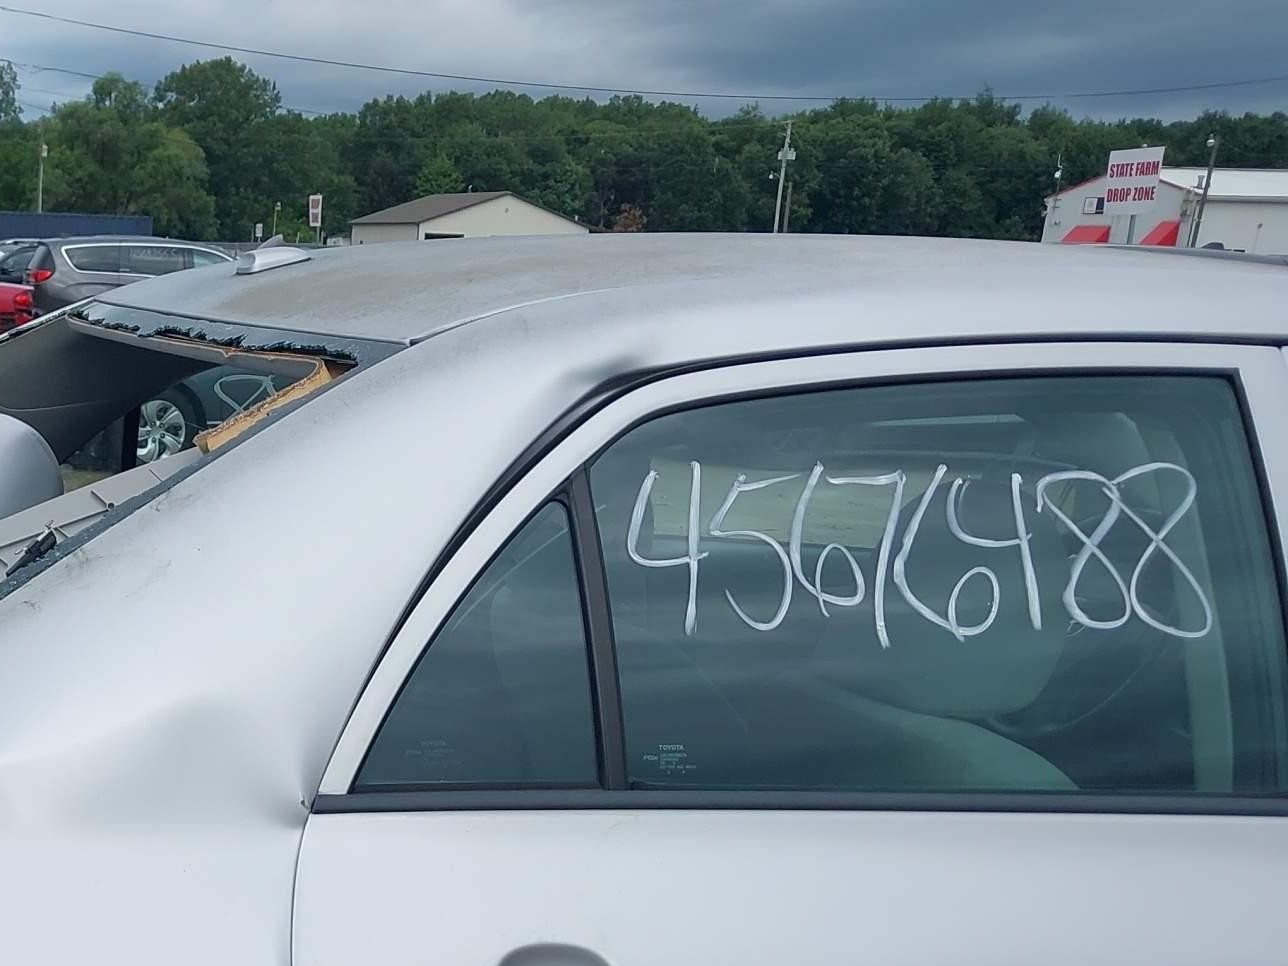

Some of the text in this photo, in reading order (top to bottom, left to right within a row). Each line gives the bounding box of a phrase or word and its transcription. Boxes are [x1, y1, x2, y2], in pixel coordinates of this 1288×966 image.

[1109, 161, 1160, 178] STATE FARM
[1106, 186, 1156, 202] DROP ZONE
[628, 461, 1212, 649] 45676488
